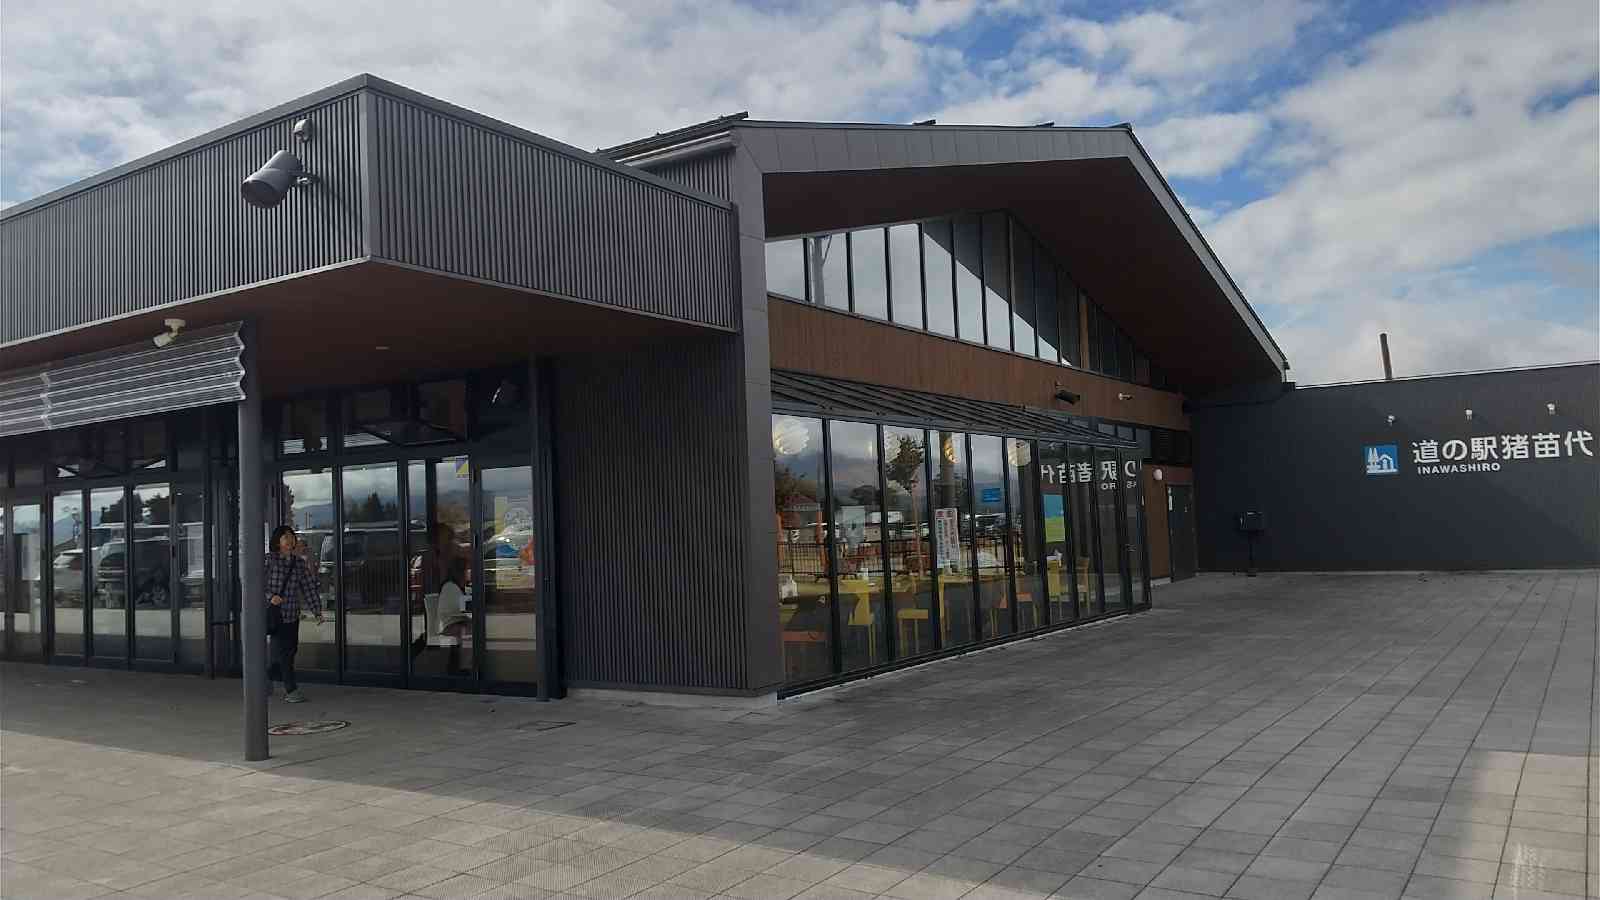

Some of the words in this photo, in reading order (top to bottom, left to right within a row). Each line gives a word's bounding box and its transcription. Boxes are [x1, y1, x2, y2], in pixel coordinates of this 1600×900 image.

[1412, 431, 1593, 463] 道の駅猪苗代
[1417, 462, 1501, 475] INAWASHIRO
